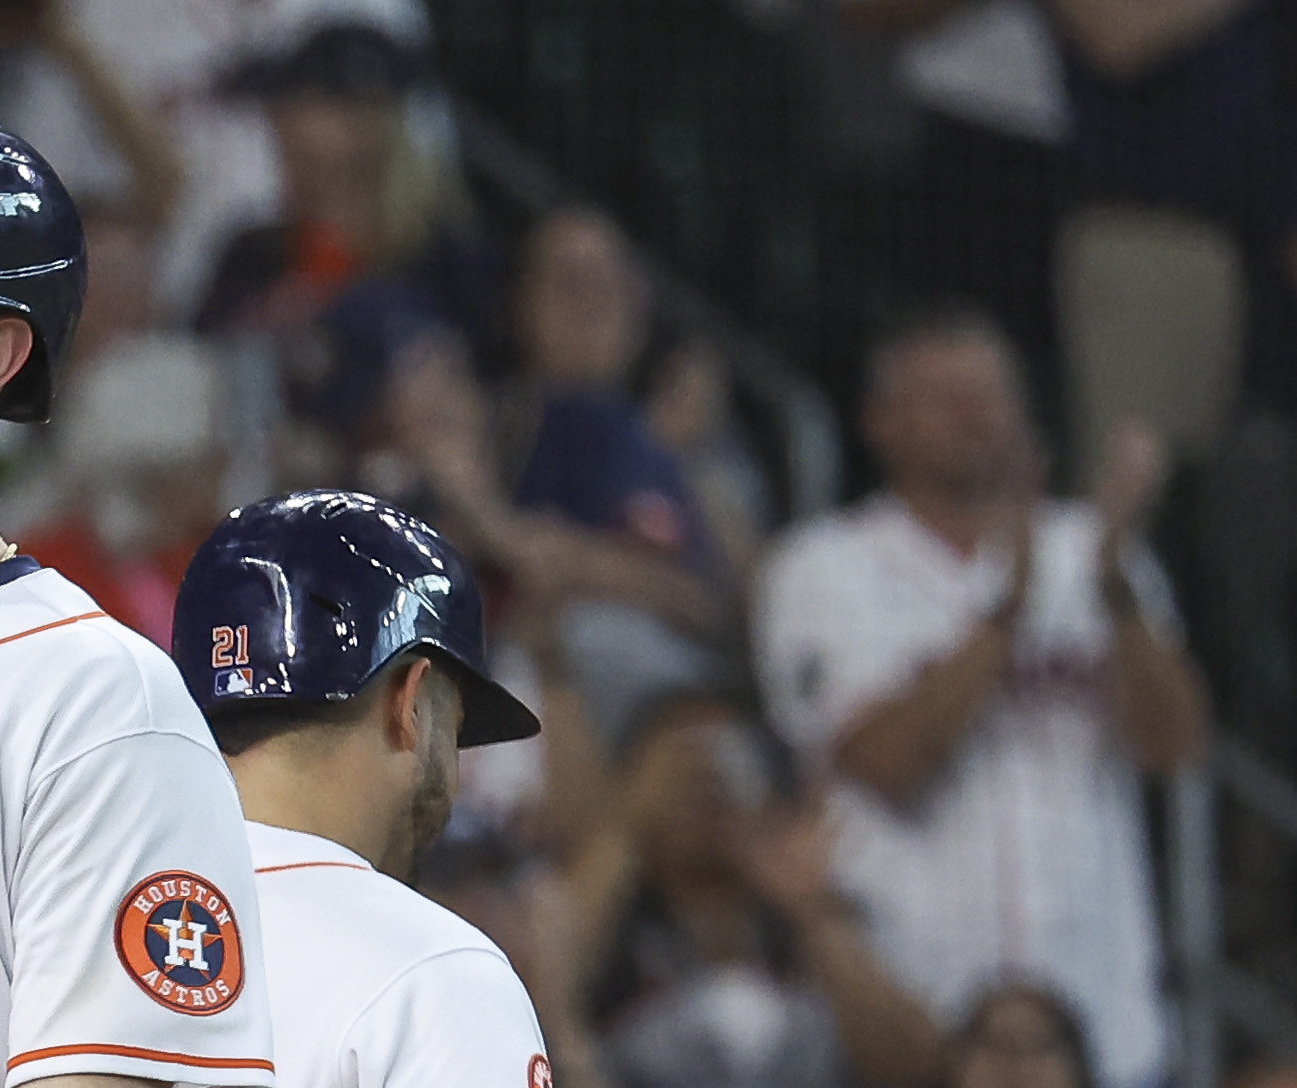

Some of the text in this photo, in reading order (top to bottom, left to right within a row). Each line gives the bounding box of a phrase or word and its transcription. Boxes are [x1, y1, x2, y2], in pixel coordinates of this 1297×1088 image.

[211, 624, 249, 669] 21
[132, 879, 232, 926] HOUSTON
[162, 918, 210, 971] H
[141, 969, 232, 1006] ASTROS
